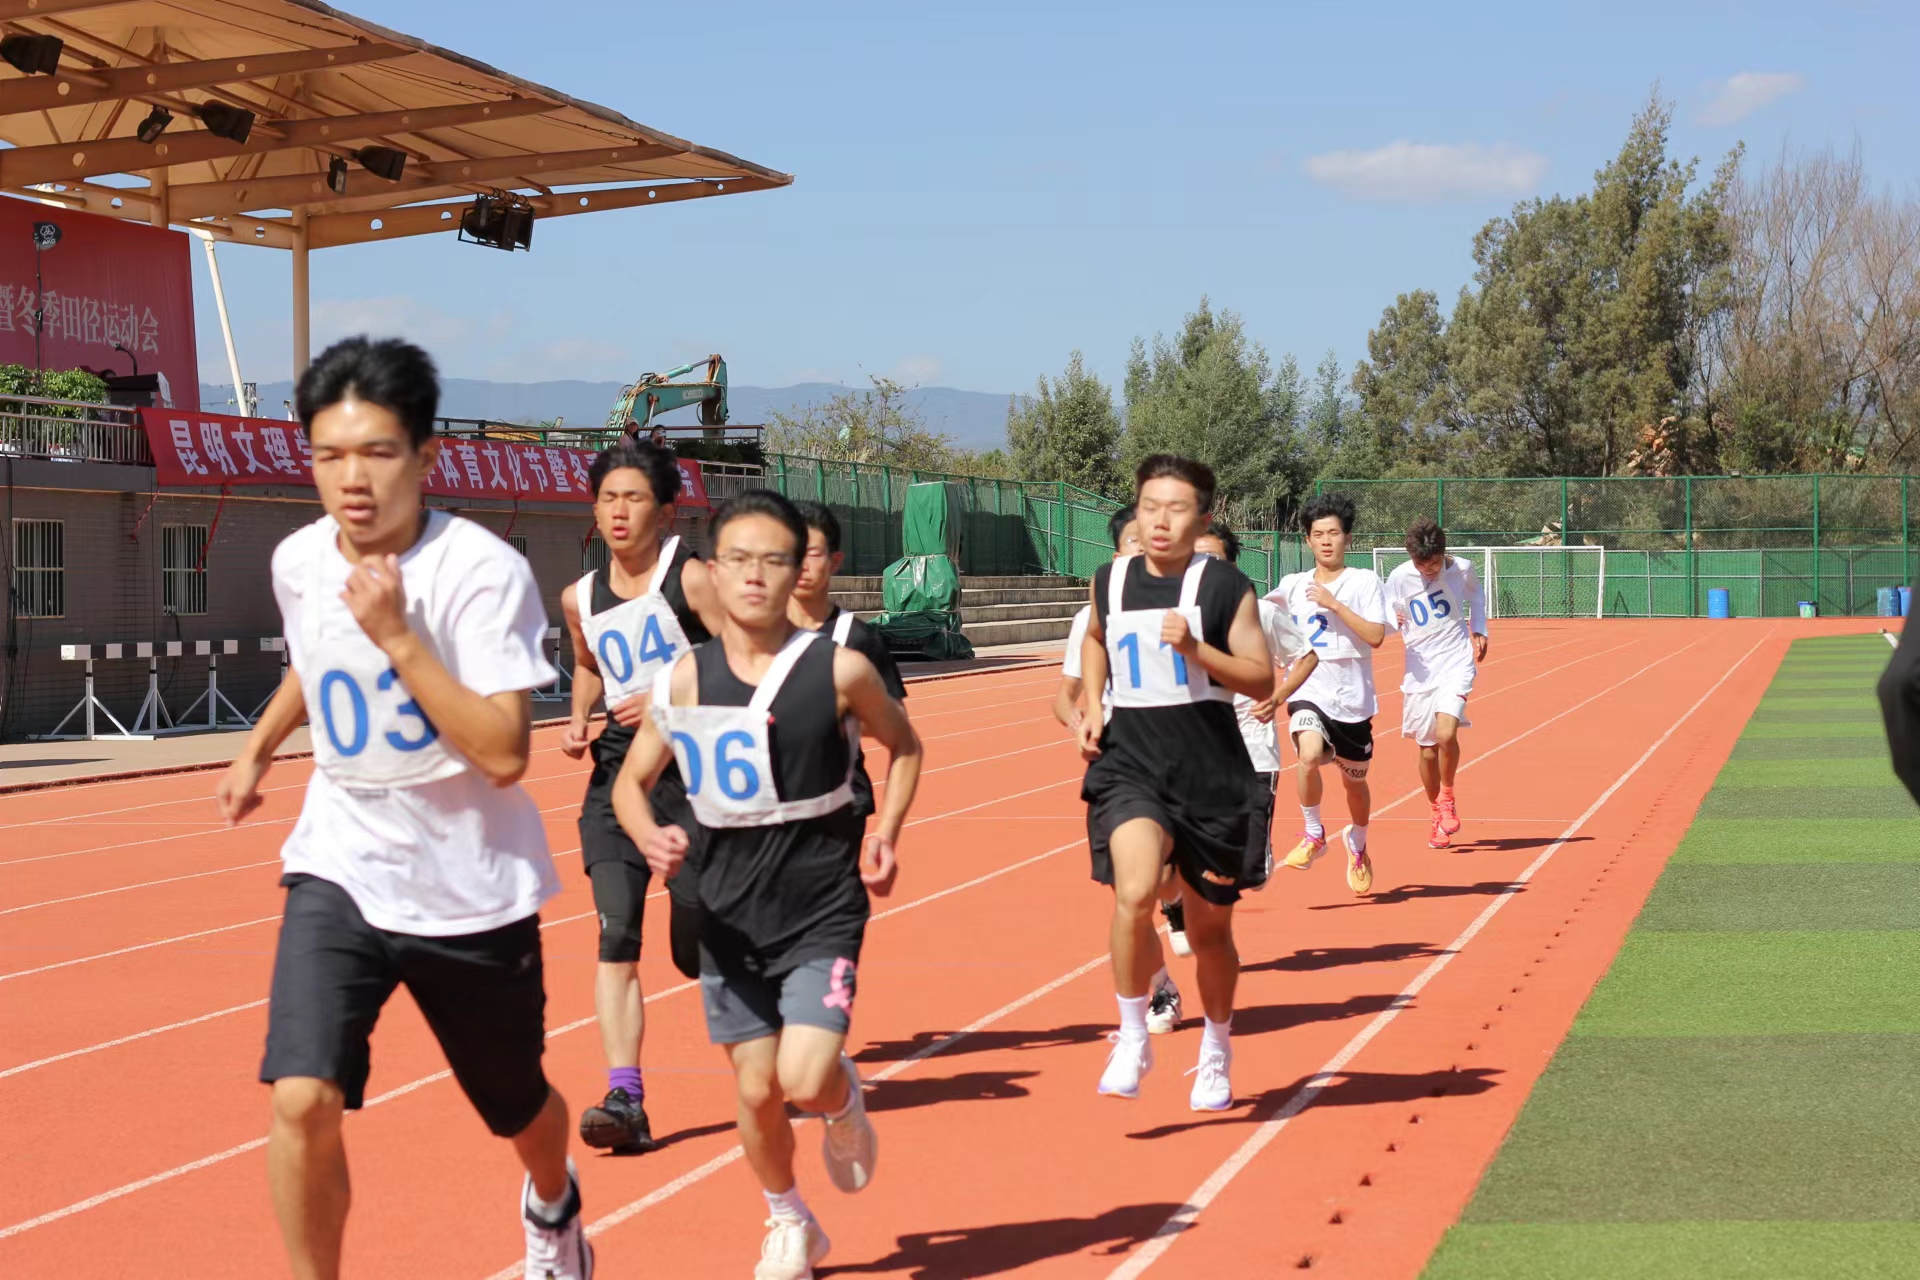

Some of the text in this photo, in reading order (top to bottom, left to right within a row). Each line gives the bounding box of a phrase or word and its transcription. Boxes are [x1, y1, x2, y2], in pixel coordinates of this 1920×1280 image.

[427, 440, 598, 493] 体育文化节暨冬
[1291, 614, 1329, 647] 2
[1410, 589, 1451, 627] 05
[598, 613, 677, 684] 04
[1117, 632, 1188, 689] 11
[320, 667, 439, 757] 03
[670, 729, 760, 801] 06
